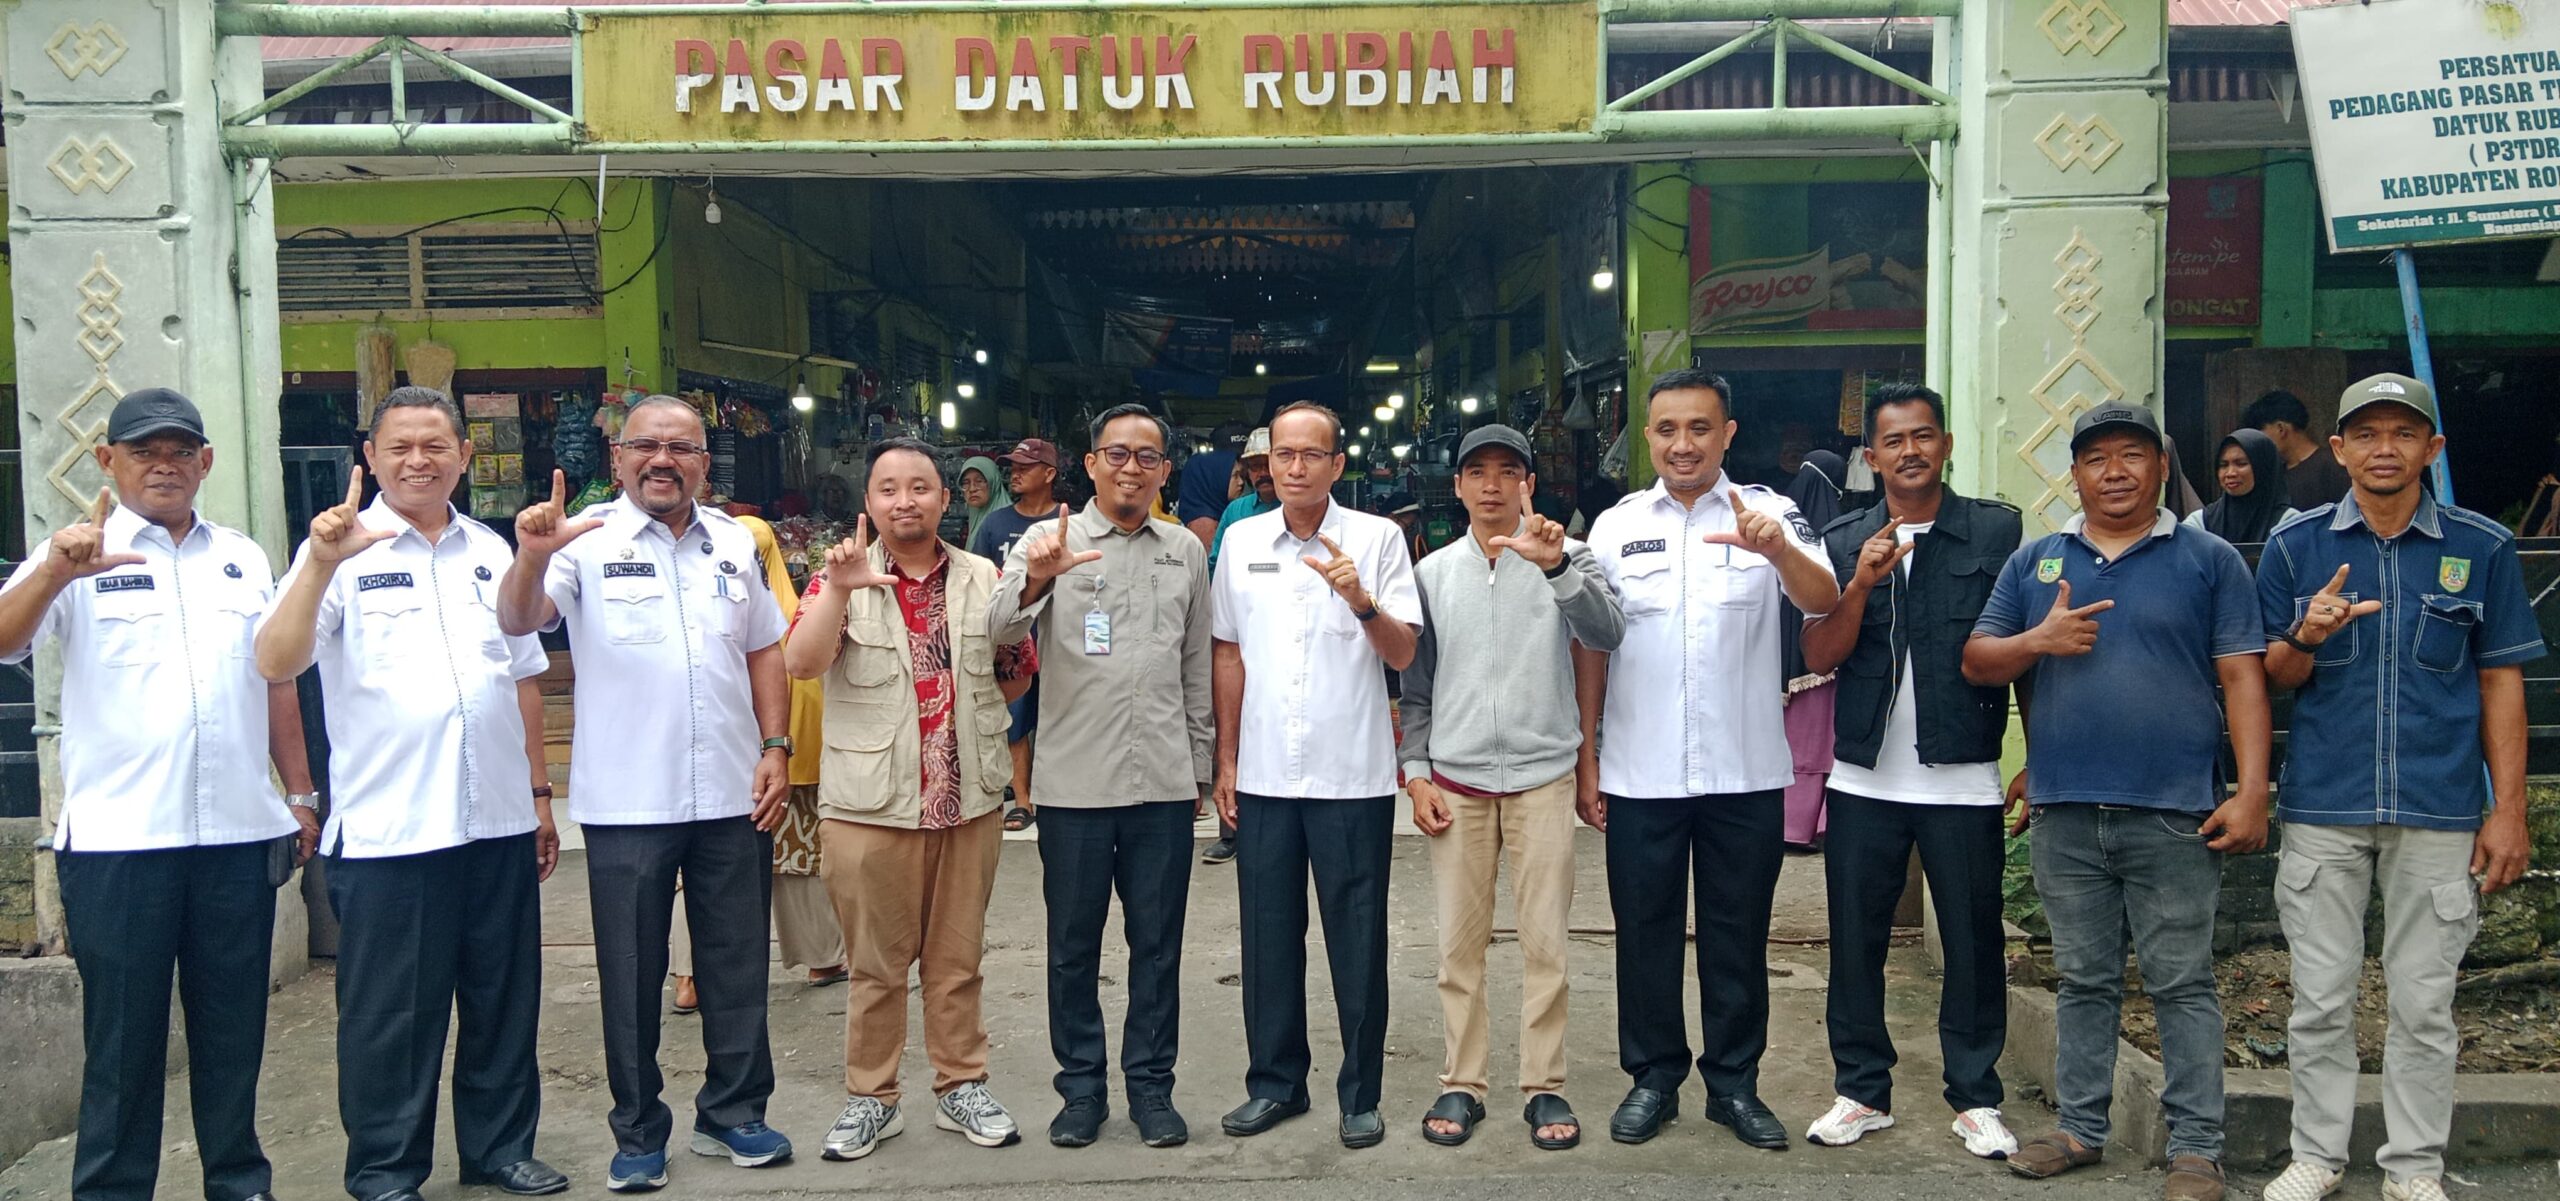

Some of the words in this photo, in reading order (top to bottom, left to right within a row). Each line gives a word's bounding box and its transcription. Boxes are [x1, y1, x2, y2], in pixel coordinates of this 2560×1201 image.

[675, 38, 903, 112] PASAR
[955, 35, 1197, 111] DATUK
[1243, 28, 1514, 109] RUBIAH
[2440, 50, 2560, 80] PERSATUA
[2329, 87, 2453, 119] PEDAGANG
[2459, 81, 2535, 106] PASAR
[2539, 79, 2560, 101] T
[2433, 111, 2511, 137] DATUK
[2516, 108, 2560, 131] RUB
[2485, 137, 2560, 162] P3TDR
[2380, 168, 2520, 200] KABUPATEN
[2526, 165, 2560, 189] RO
[1700, 274, 1817, 316] Royco
[2169, 298, 2251, 316] ONGAT
[1622, 540, 1664, 556] CARLOS
[361, 573, 412, 589] KHOIRUL
[606, 564, 653, 575] SUWANDI
